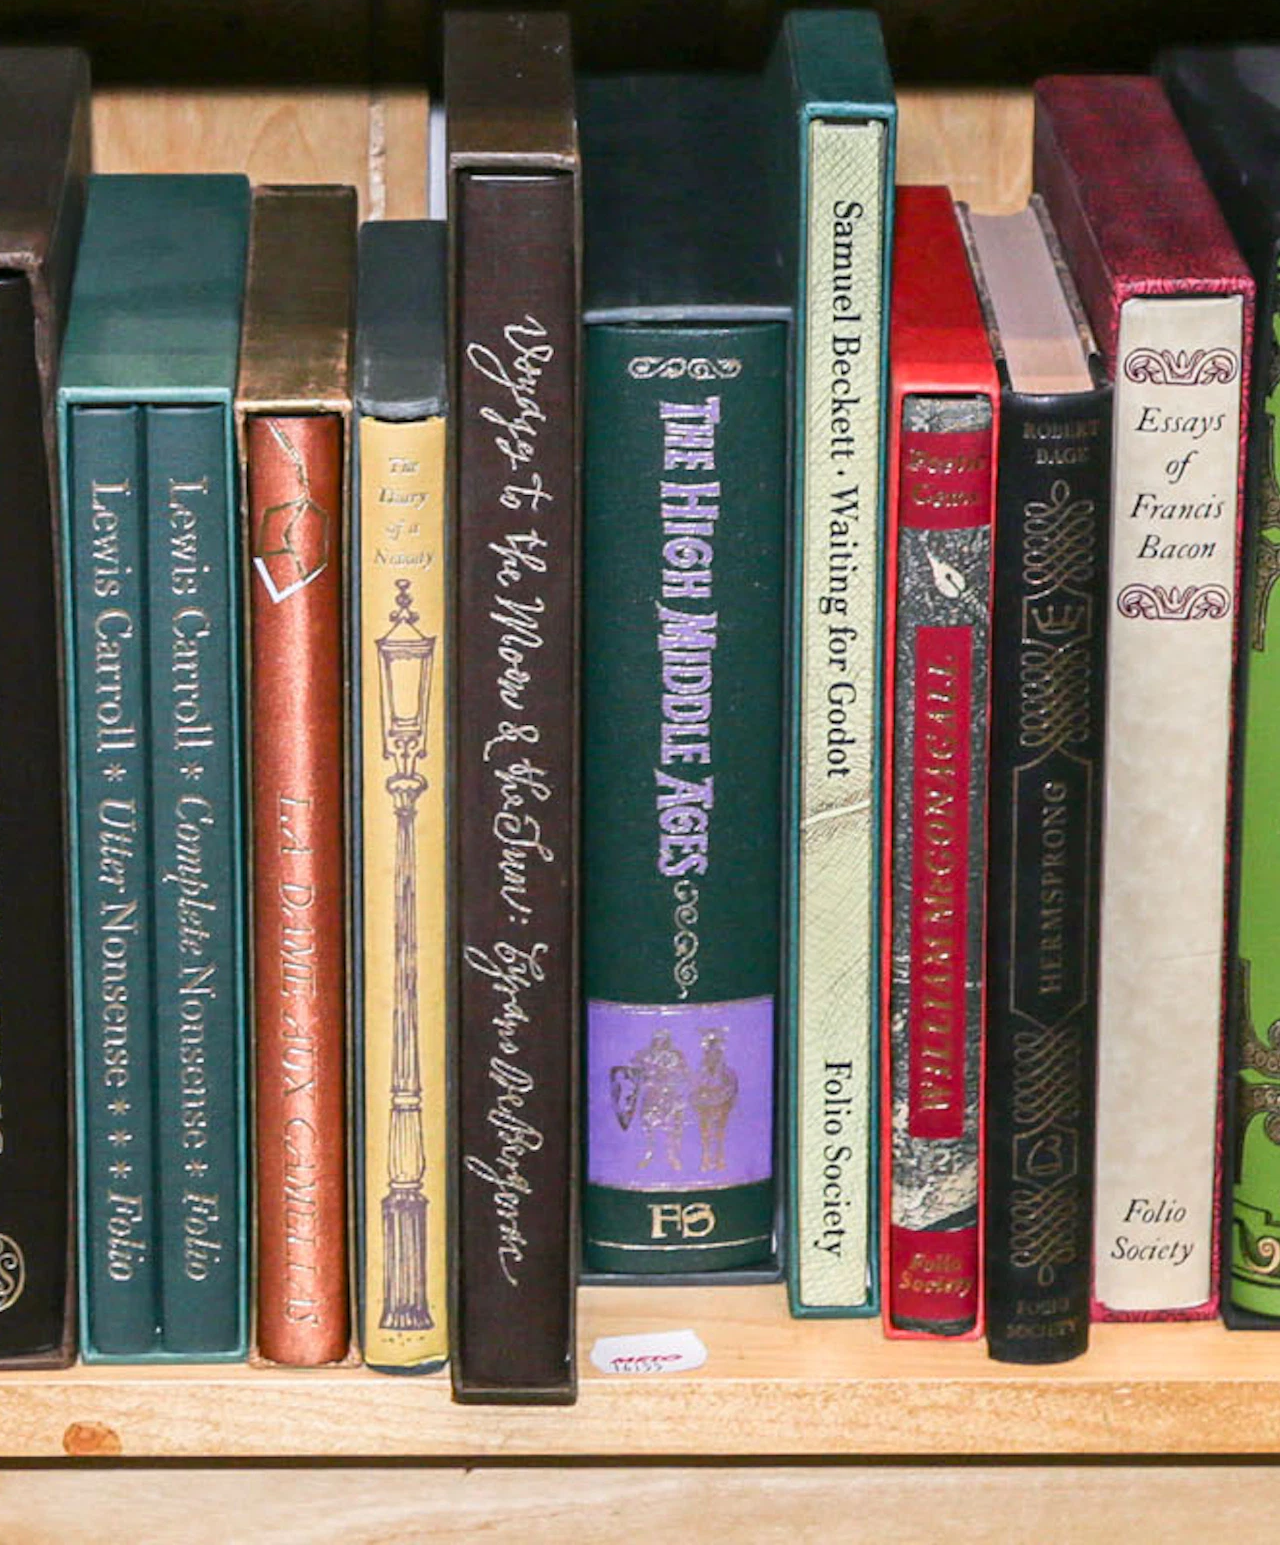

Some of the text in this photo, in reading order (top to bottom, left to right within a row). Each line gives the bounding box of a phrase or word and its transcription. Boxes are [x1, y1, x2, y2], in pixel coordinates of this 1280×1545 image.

[1134, 407, 1225, 440] Essays
[499, 472, 555, 511] to
[819, 199, 863, 778] Samuel Beckett Waiting for Godot
[1164, 450, 1200, 484] of
[1129, 491, 1226, 521] Francis
[487, 528, 549, 587] the
[1137, 533, 1216, 560] Bacon
[494, 594, 547, 711] Moon
[652, 396, 720, 878] THE HIGH MIDDLE AGES
[91, 478, 147, 1283] Lewis Carroll Utter Nonsense Folio
[162, 477, 222, 1282] Lewis Carroll Complete Nonsense Folio
[1037, 780, 1071, 995] HERMSPRONG
[812, 1060, 853, 1260] Folio Society
[647, 1202, 716, 1240] FS
[1123, 1197, 1188, 1229] Folio
[1110, 1234, 1195, 1266] Society
